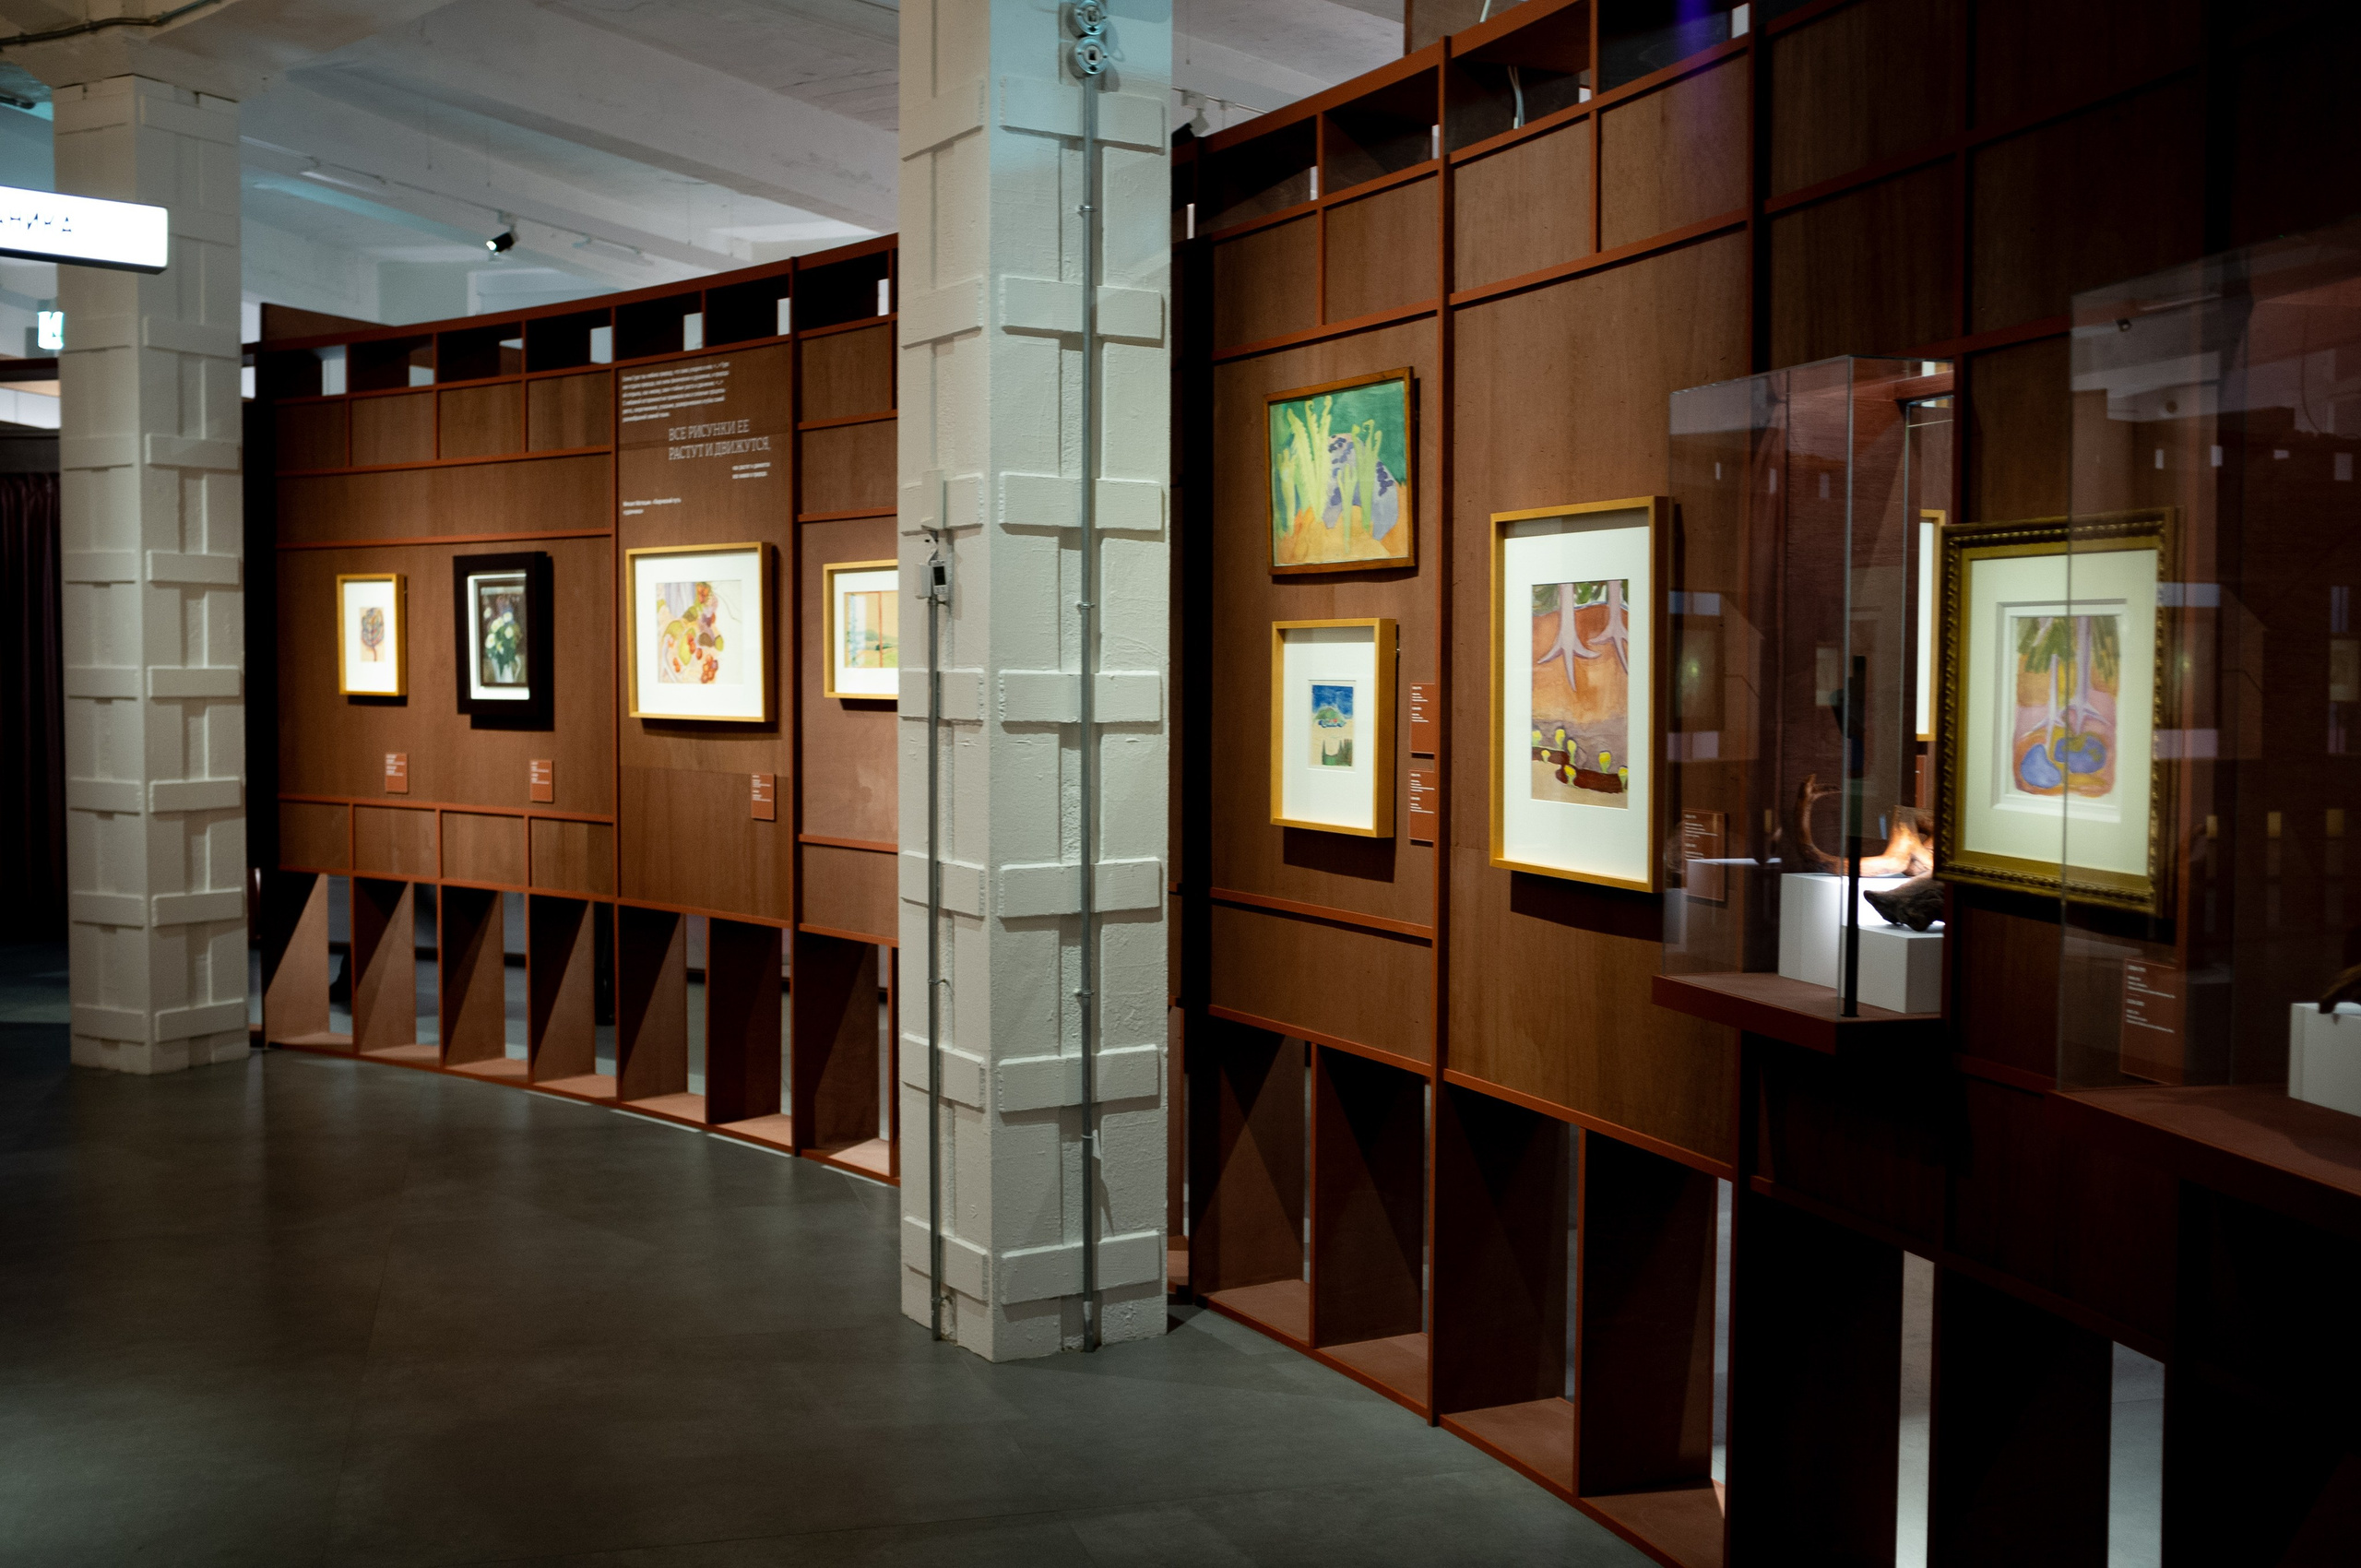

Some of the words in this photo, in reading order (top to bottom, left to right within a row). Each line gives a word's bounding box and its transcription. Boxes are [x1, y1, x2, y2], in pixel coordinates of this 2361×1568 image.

[0, 208, 72, 232] НИКА
[669, 426, 687, 441] ВСЕ
[688, 421, 736, 439] РИСУНКИ
[737, 419, 750, 433] ЕЕ
[669, 444, 704, 460] РАСТУТ
[706, 443, 714, 457] И
